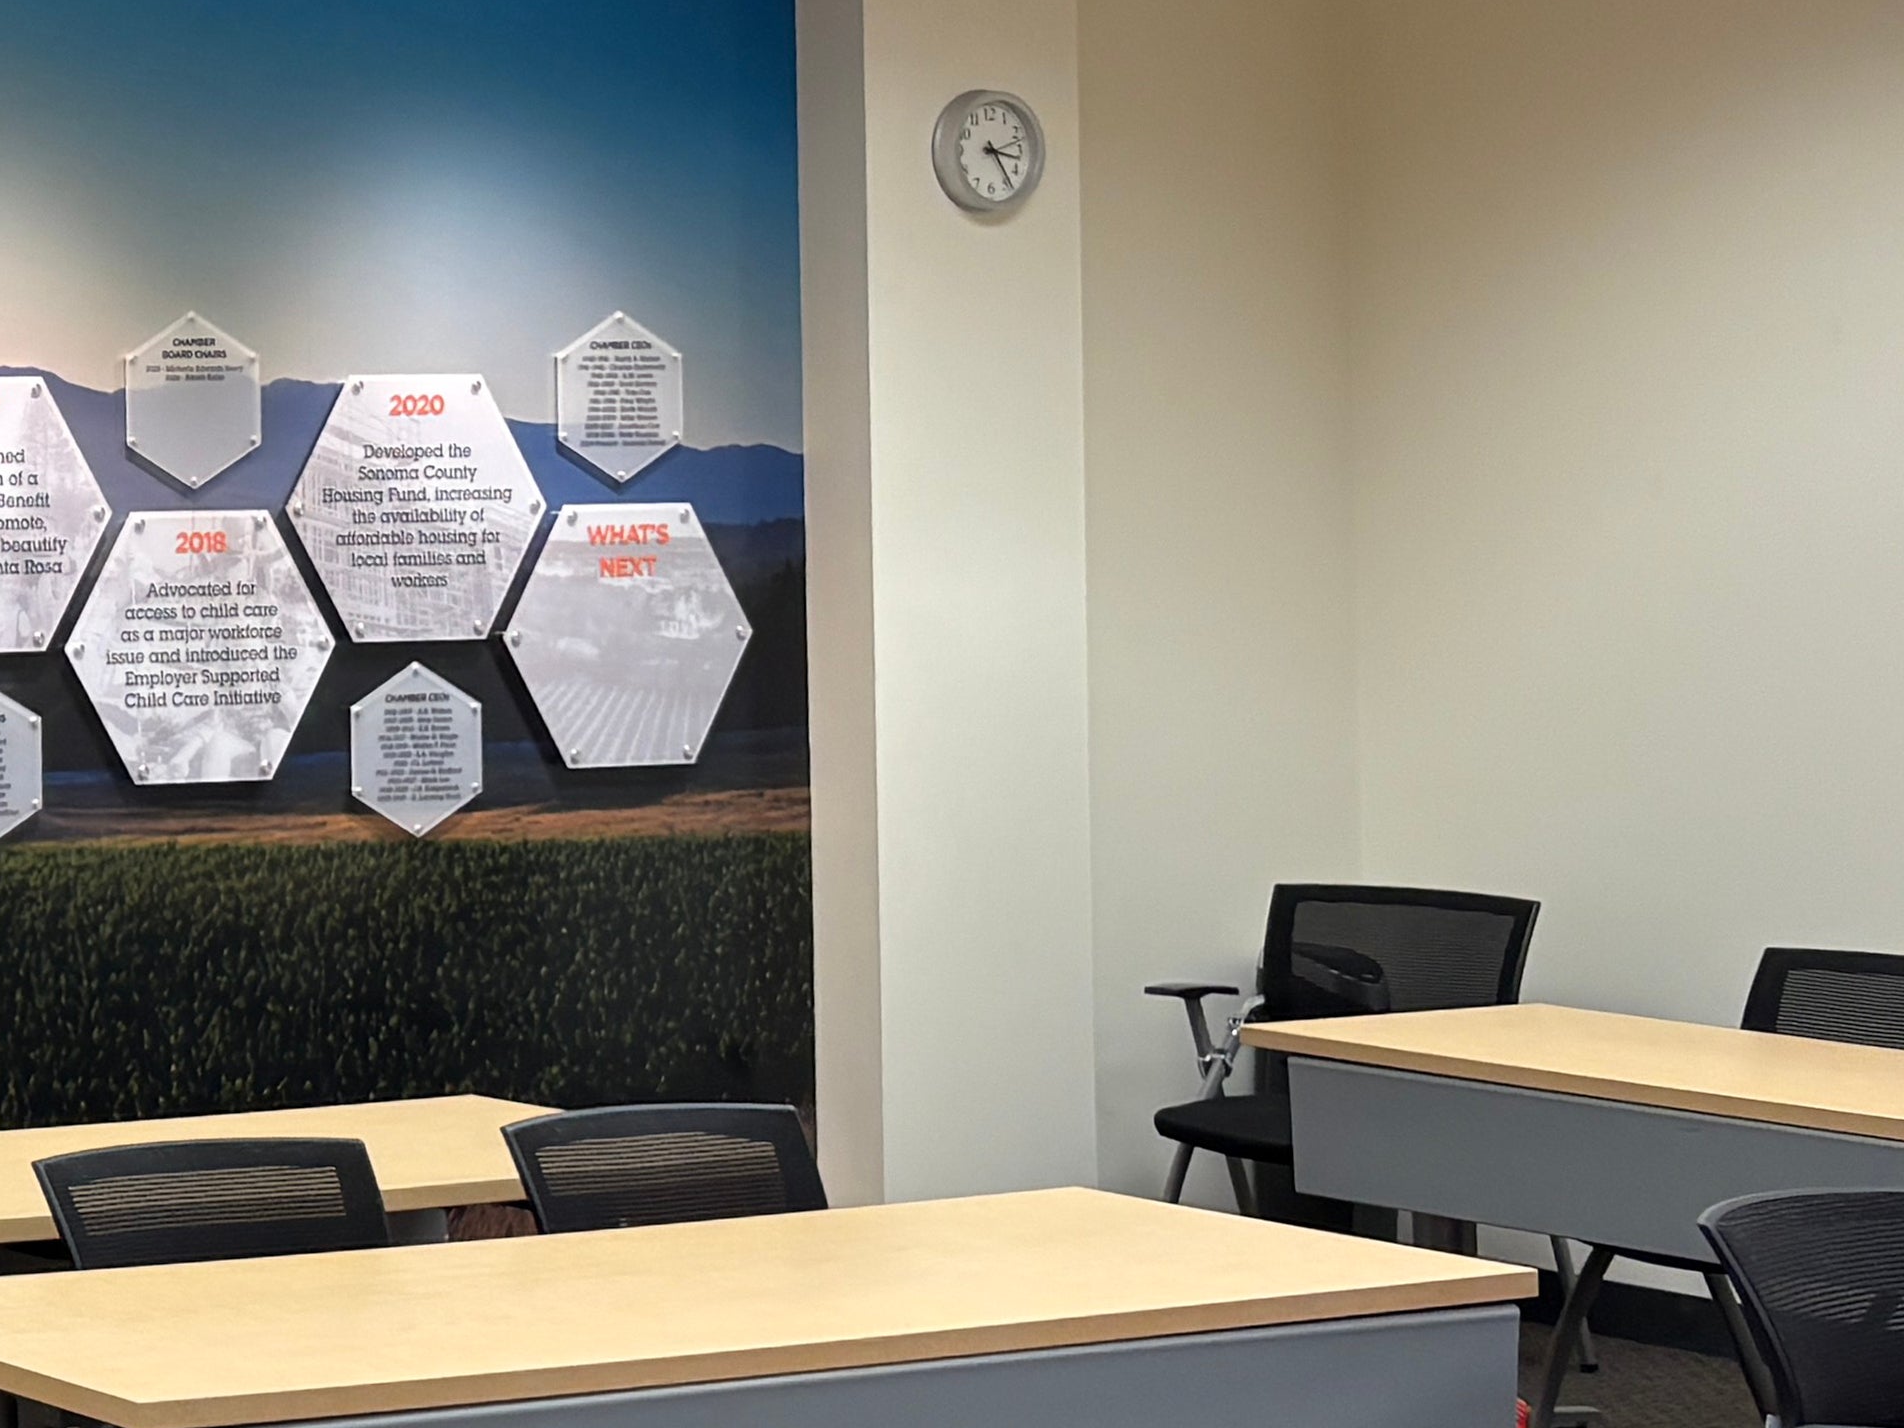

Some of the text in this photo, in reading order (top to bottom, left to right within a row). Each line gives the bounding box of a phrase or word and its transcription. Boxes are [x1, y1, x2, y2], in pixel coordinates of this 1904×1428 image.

[389, 394, 444, 416] 2020
[362, 442, 472, 462] Developed the
[357, 464, 477, 483] Sonoma County
[176, 531, 228, 555] 2018
[587, 524, 671, 546] WHAT'S
[24, 559, 63, 574] Rosa
[599, 555, 657, 579] NEXT
[146, 581, 256, 597] Advocated for
[123, 689, 282, 707] Child Care Initiative
